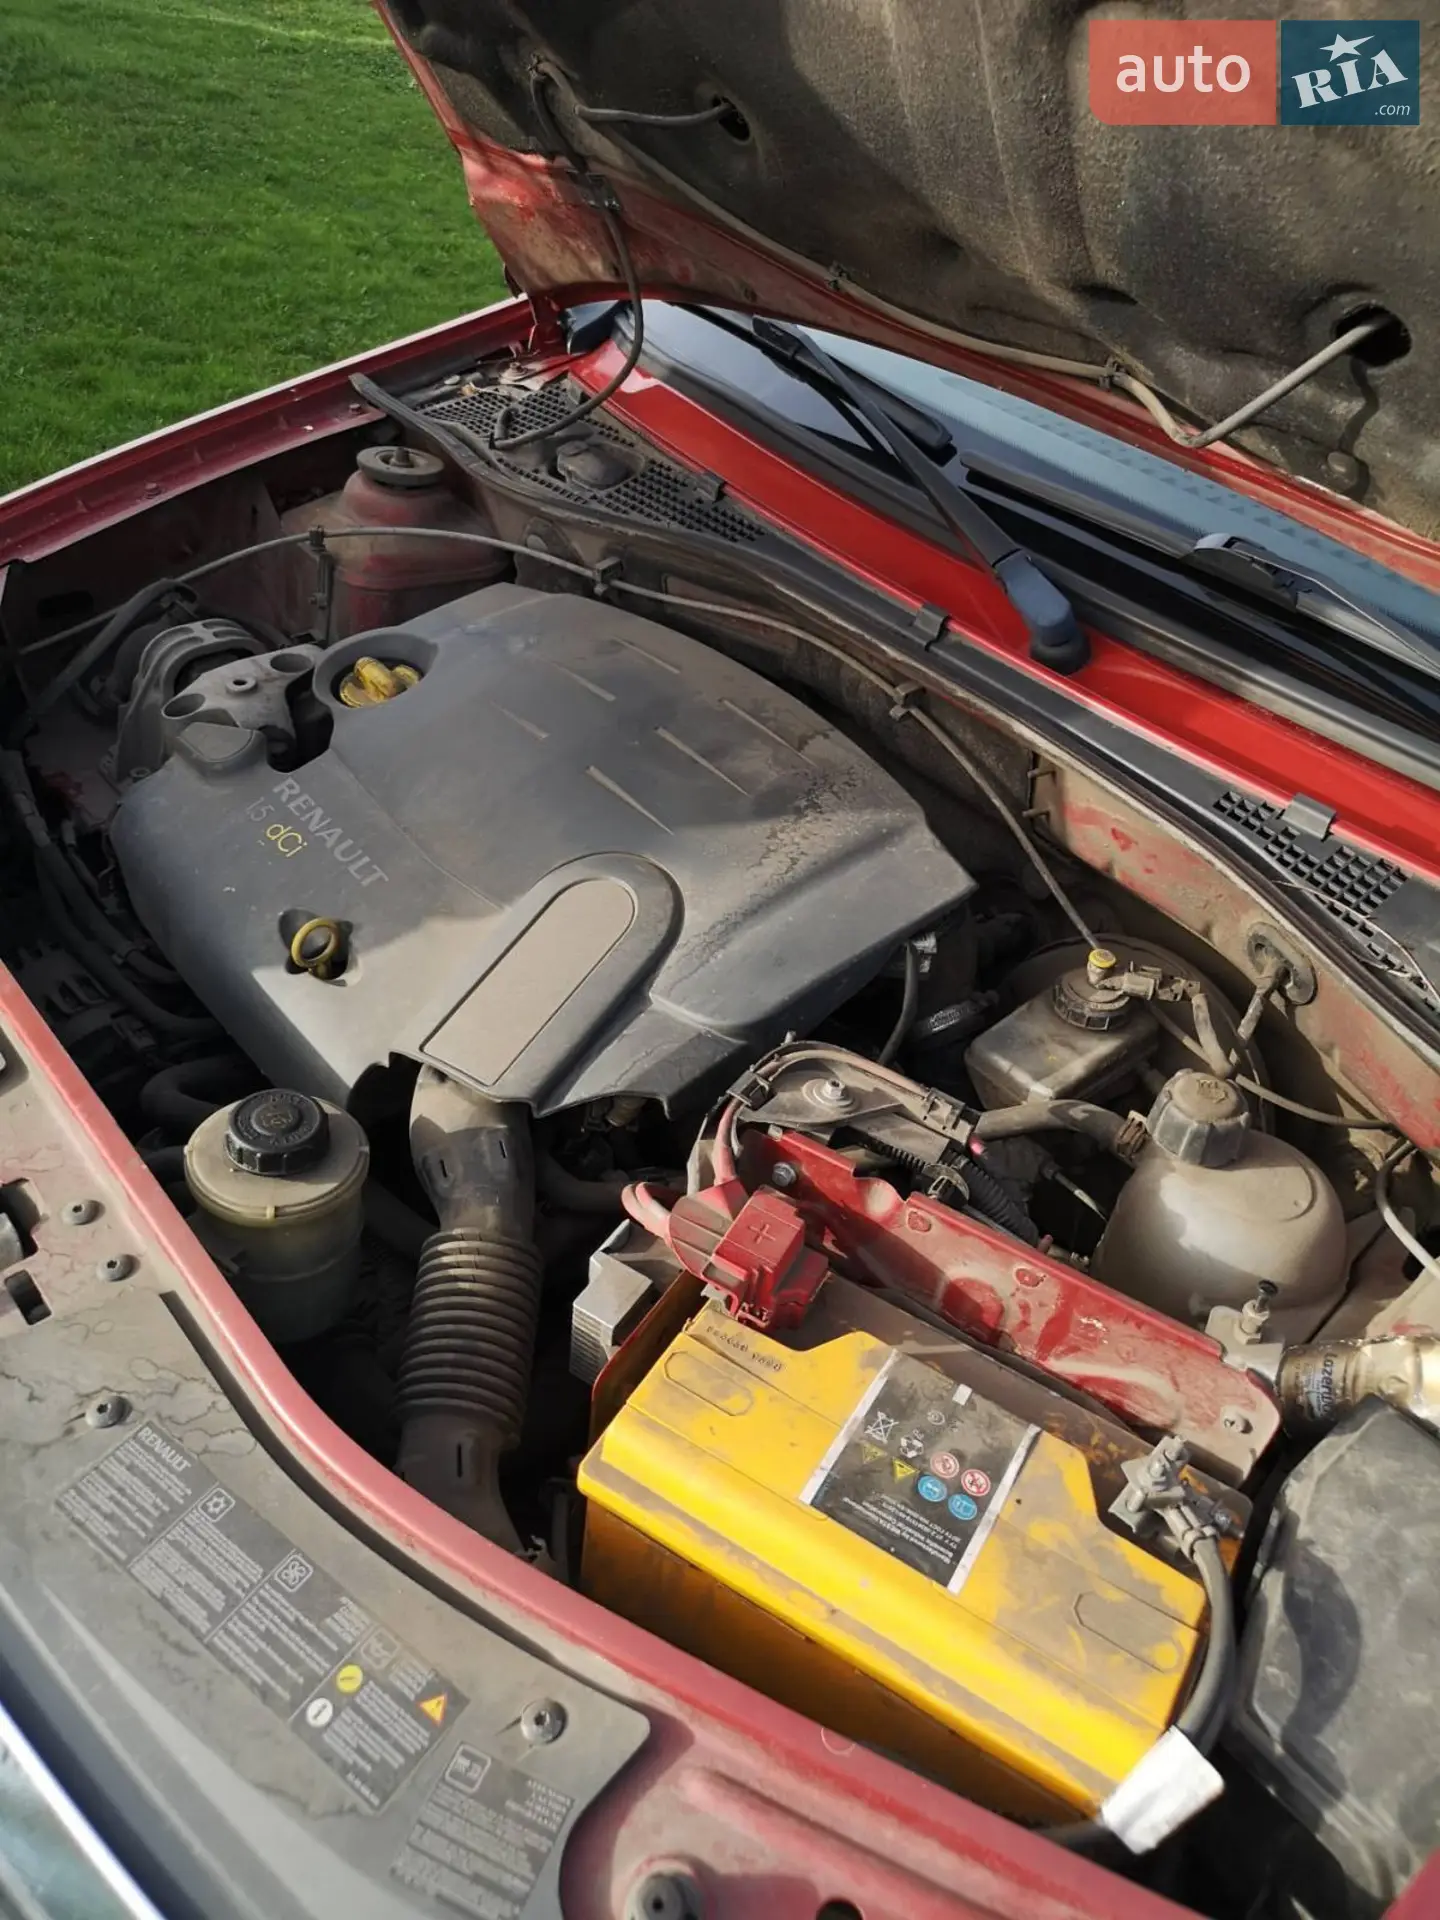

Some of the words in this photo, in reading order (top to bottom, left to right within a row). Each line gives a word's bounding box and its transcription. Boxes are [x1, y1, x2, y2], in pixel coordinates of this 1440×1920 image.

[266, 823, 308, 858] dCi
[272, 777, 389, 887] RENAULT
[137, 1426, 192, 1472] RENAULT
